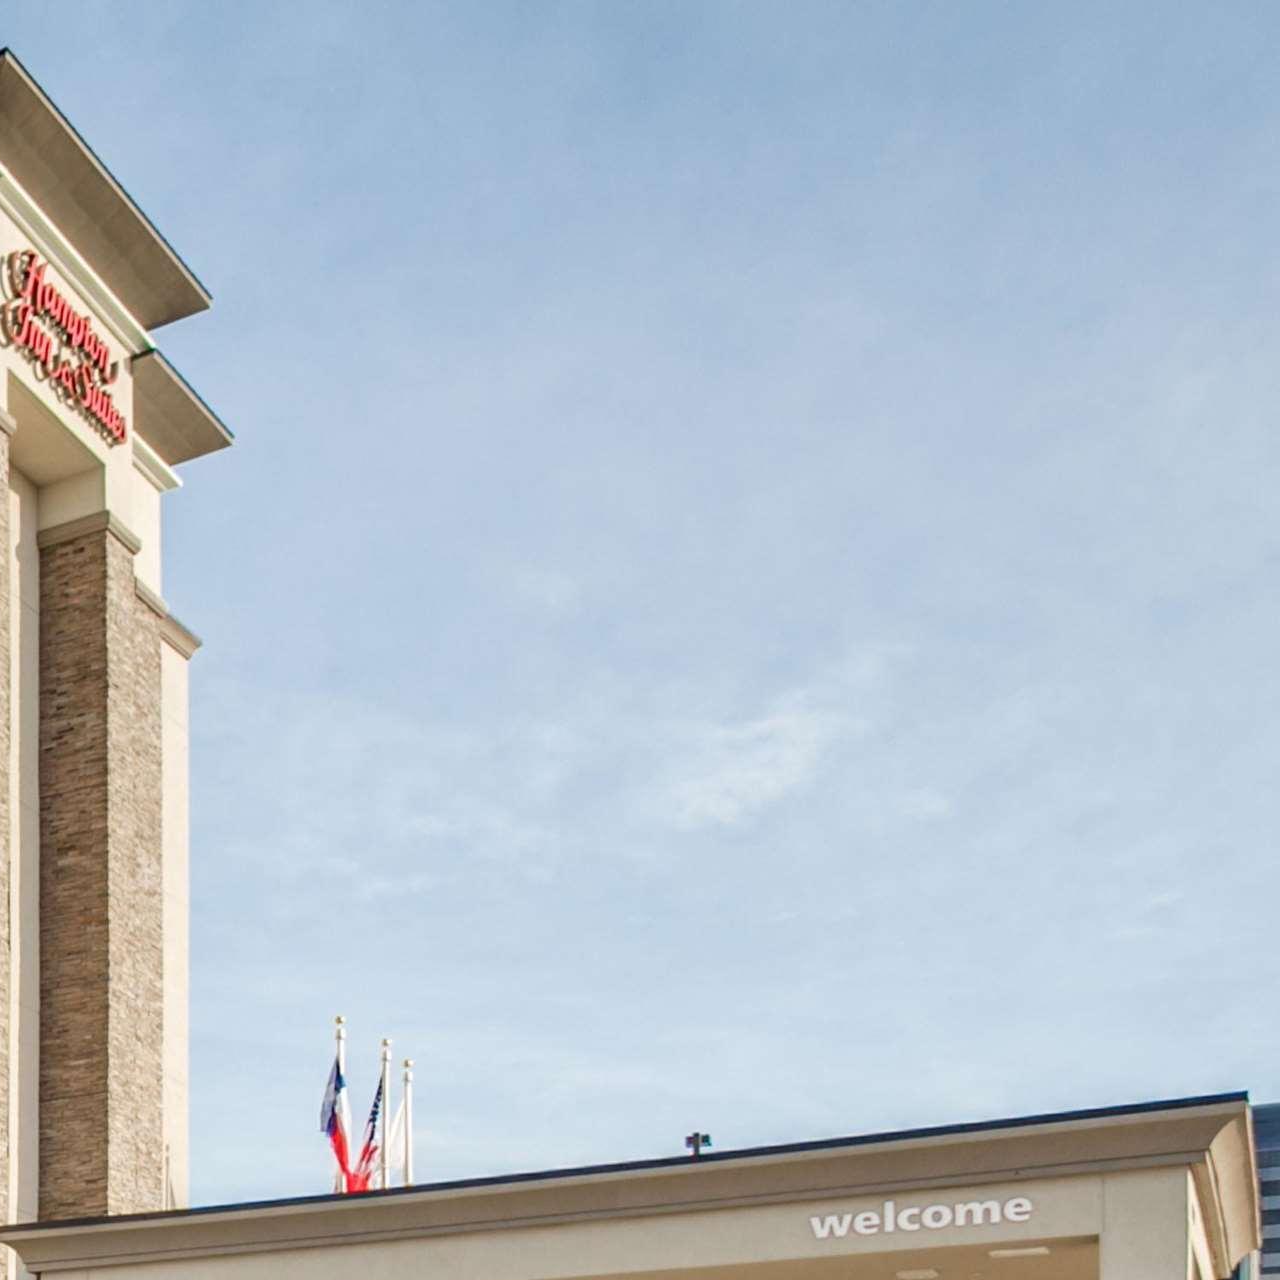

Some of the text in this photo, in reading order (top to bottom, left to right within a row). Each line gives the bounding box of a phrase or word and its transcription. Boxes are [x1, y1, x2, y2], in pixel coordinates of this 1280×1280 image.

[7, 250, 118, 385] Hampton
[75, 362, 127, 444] Suites
[809, 1196, 1033, 1240] welcome
